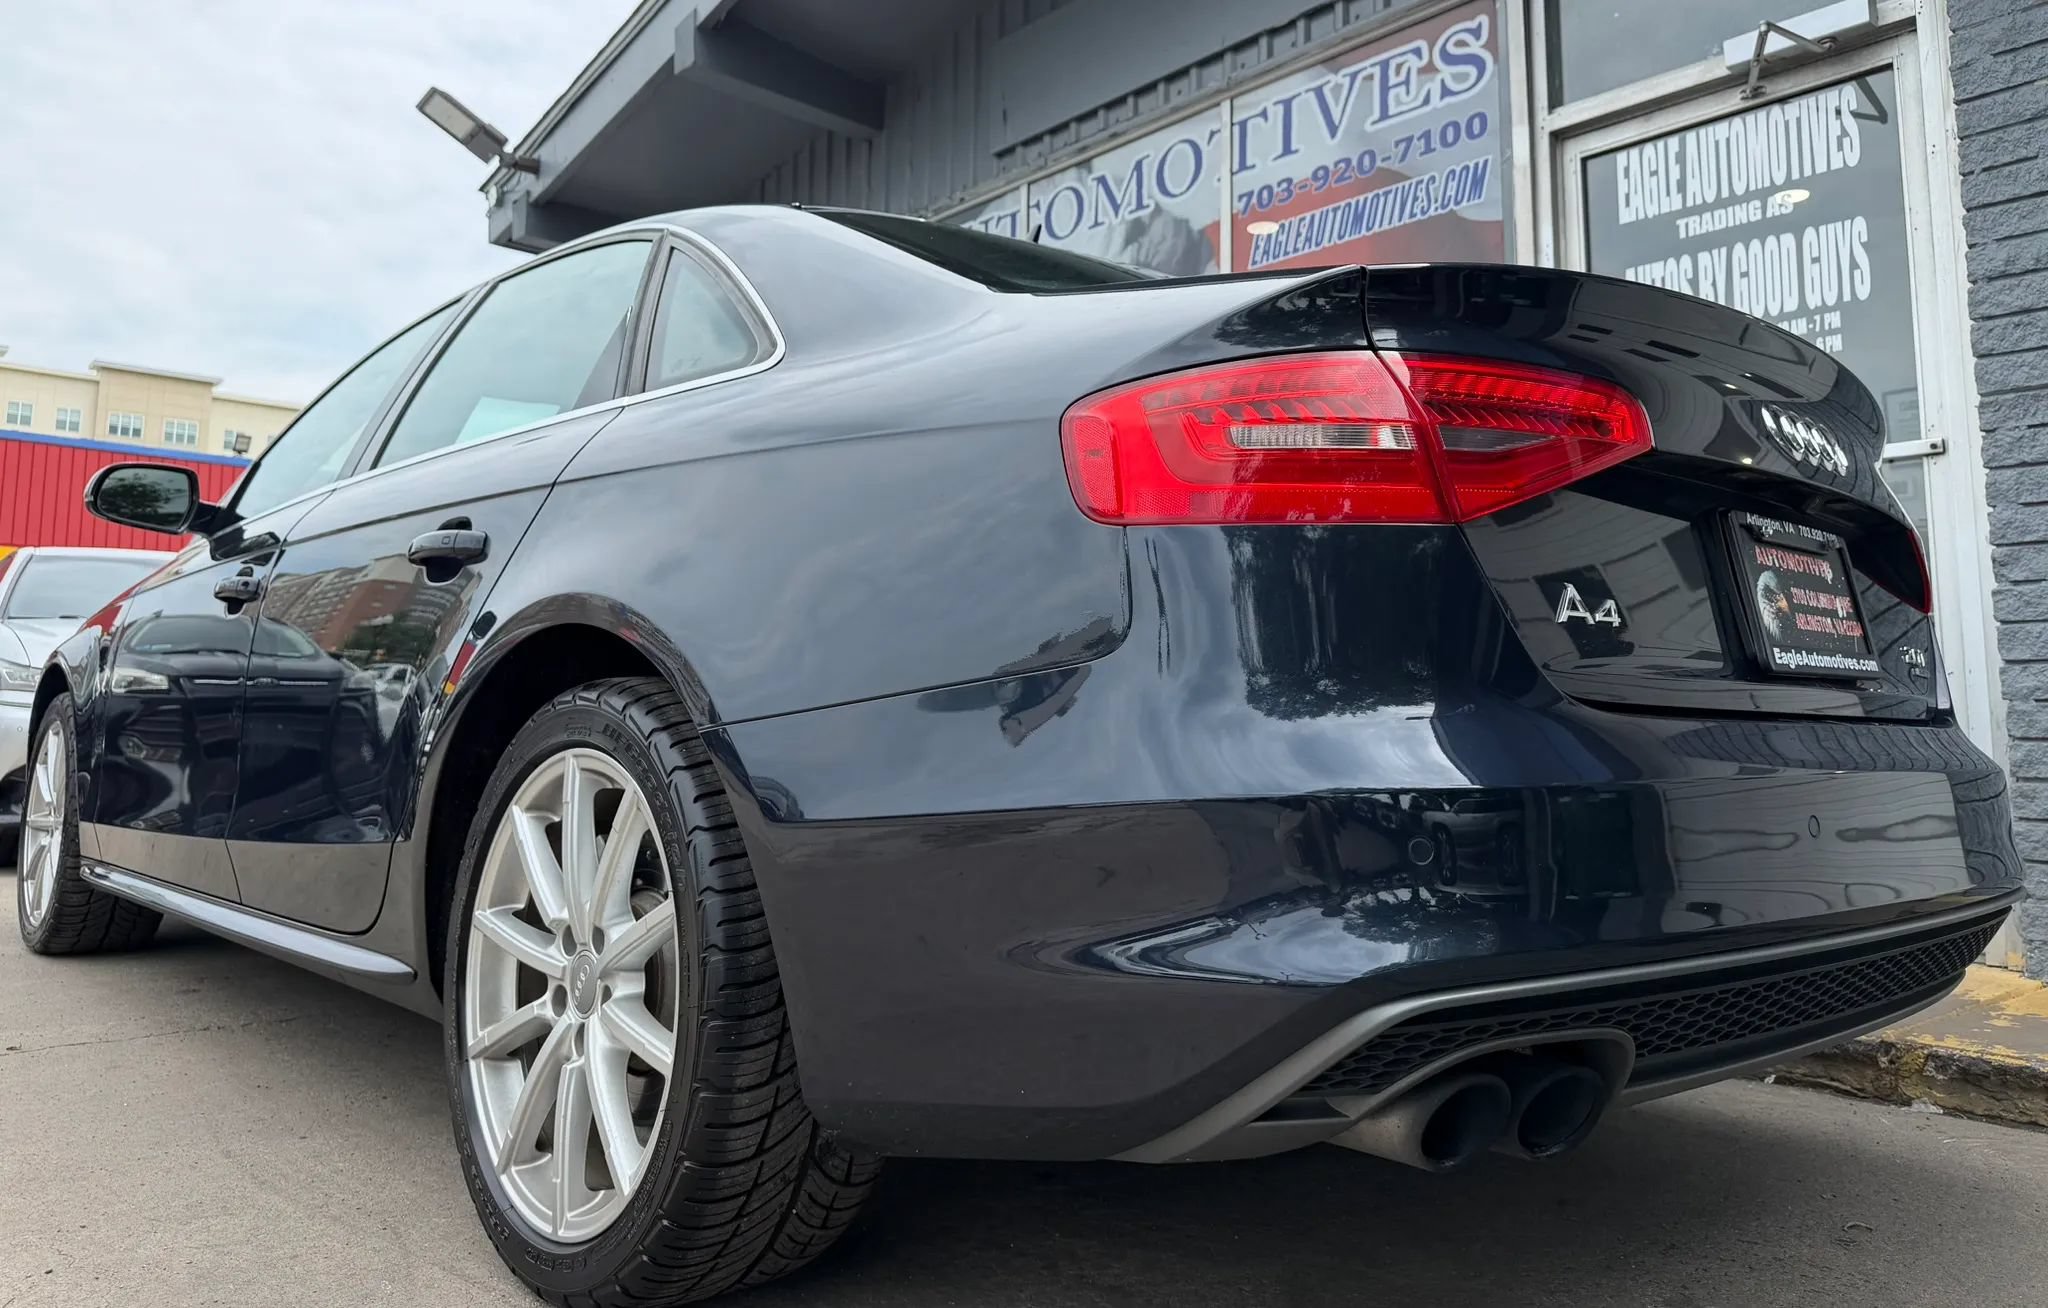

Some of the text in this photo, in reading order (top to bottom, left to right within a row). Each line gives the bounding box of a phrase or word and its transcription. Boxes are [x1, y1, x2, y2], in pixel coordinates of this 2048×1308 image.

[1237, 110, 1489, 217] 703-920-7100
[1616, 85, 1861, 225] EAGLE AUTOMOTIVES
[1249, 155, 1490, 269] EAGLEAUTOMOTIVES.COM
[1675, 192, 1794, 239] TRADING AS
[1697, 246, 1728, 307] BY
[1731, 232, 1798, 320] GOOD
[1802, 215, 1872, 310] GUYS
[1783, 520, 1796, 534] VA
[1555, 582, 1622, 627] A4
[1772, 646, 1879, 672] EagleAutomotives.com
